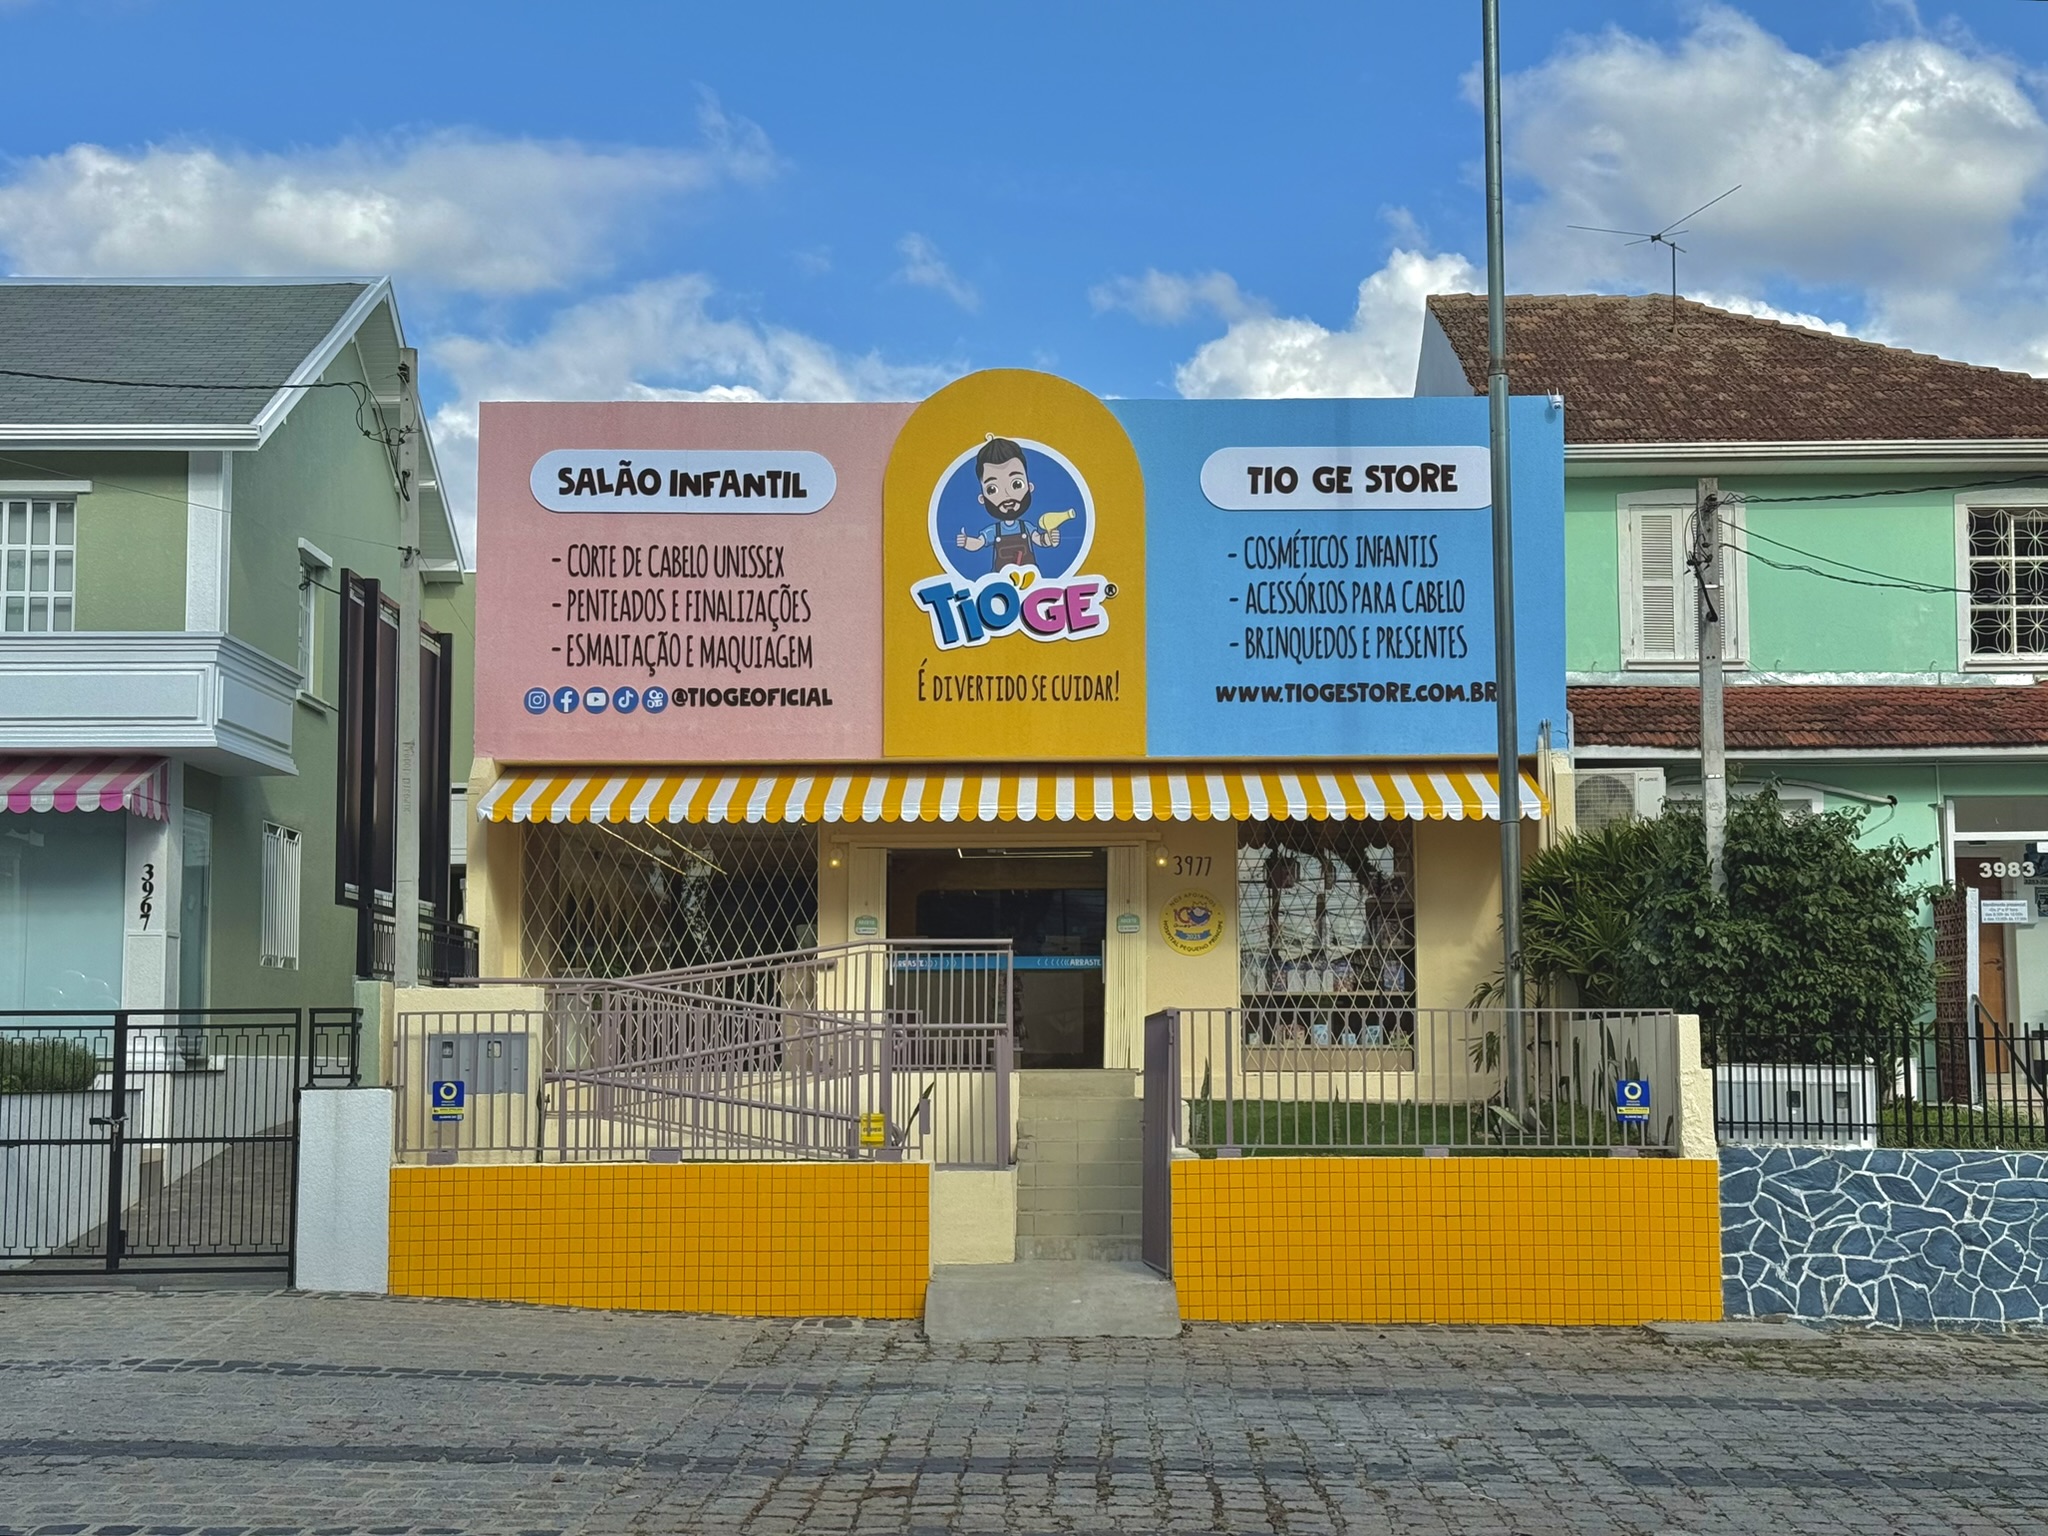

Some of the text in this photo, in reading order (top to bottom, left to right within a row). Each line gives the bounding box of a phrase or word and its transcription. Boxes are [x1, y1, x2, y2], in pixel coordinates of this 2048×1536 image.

[558, 460, 807, 498] SALÃO INFANTIL
[1248, 463, 1457, 494] TIO GE STORE
[568, 544, 617, 577] CORTE
[623, 546, 642, 577] DE
[648, 545, 708, 578] CABELO
[714, 545, 784, 578] UNISSEX
[1245, 529, 1348, 569] COSMÉTICOS
[1355, 535, 1438, 568] INFANTIS
[567, 589, 666, 622] PENTEADOS
[672, 590, 680, 622] E
[686, 584, 811, 632] FINALIZAÇÕES
[1246, 573, 1347, 614] ACESSÓRIOS
[1352, 582, 1396, 613] PARA
[1403, 579, 1464, 613] CABELO
[567, 631, 680, 677] ESMALTAÇÃO
[687, 635, 693, 667] E
[701, 635, 812, 673] MAQUIAGEM
[1246, 625, 1357, 664] BRINQUEDOS
[1363, 627, 1370, 659] E
[1377, 625, 1467, 658] PRESENTES
[672, 688, 832, 707] @TIOGEOFICIAL
[919, 658, 1119, 701] É DIVERTIDO SE CUIDAR!
[1173, 855, 1212, 876] 3977
[1979, 862, 2036, 878] 3983
[139, 863, 155, 931] 3967
[893, 959, 924, 967] ARRASE
[1069, 958, 1101, 966] ARRASTE
